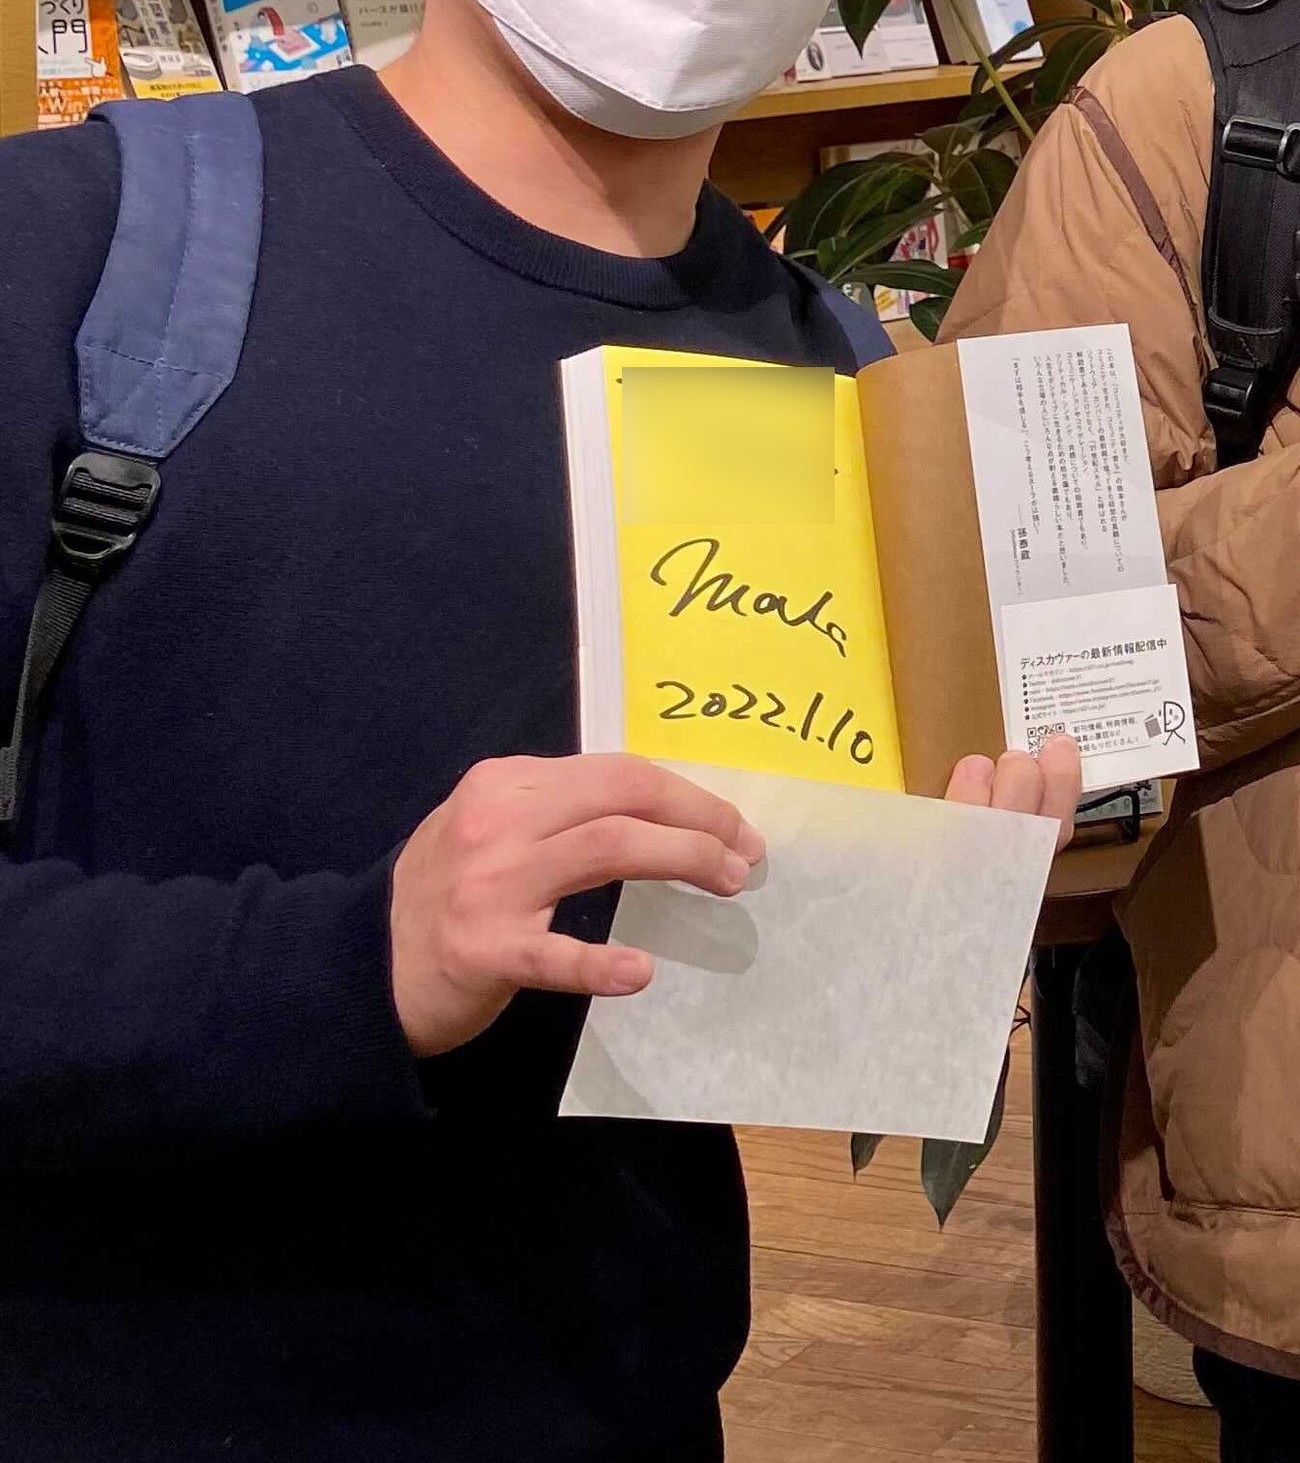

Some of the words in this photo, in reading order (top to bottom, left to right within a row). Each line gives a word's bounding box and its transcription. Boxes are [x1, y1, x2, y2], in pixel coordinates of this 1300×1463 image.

[1020, 638, 1168, 670] ディスカヴァーの最新情報配信中
[655, 680, 875, 764] 2022.1.10
